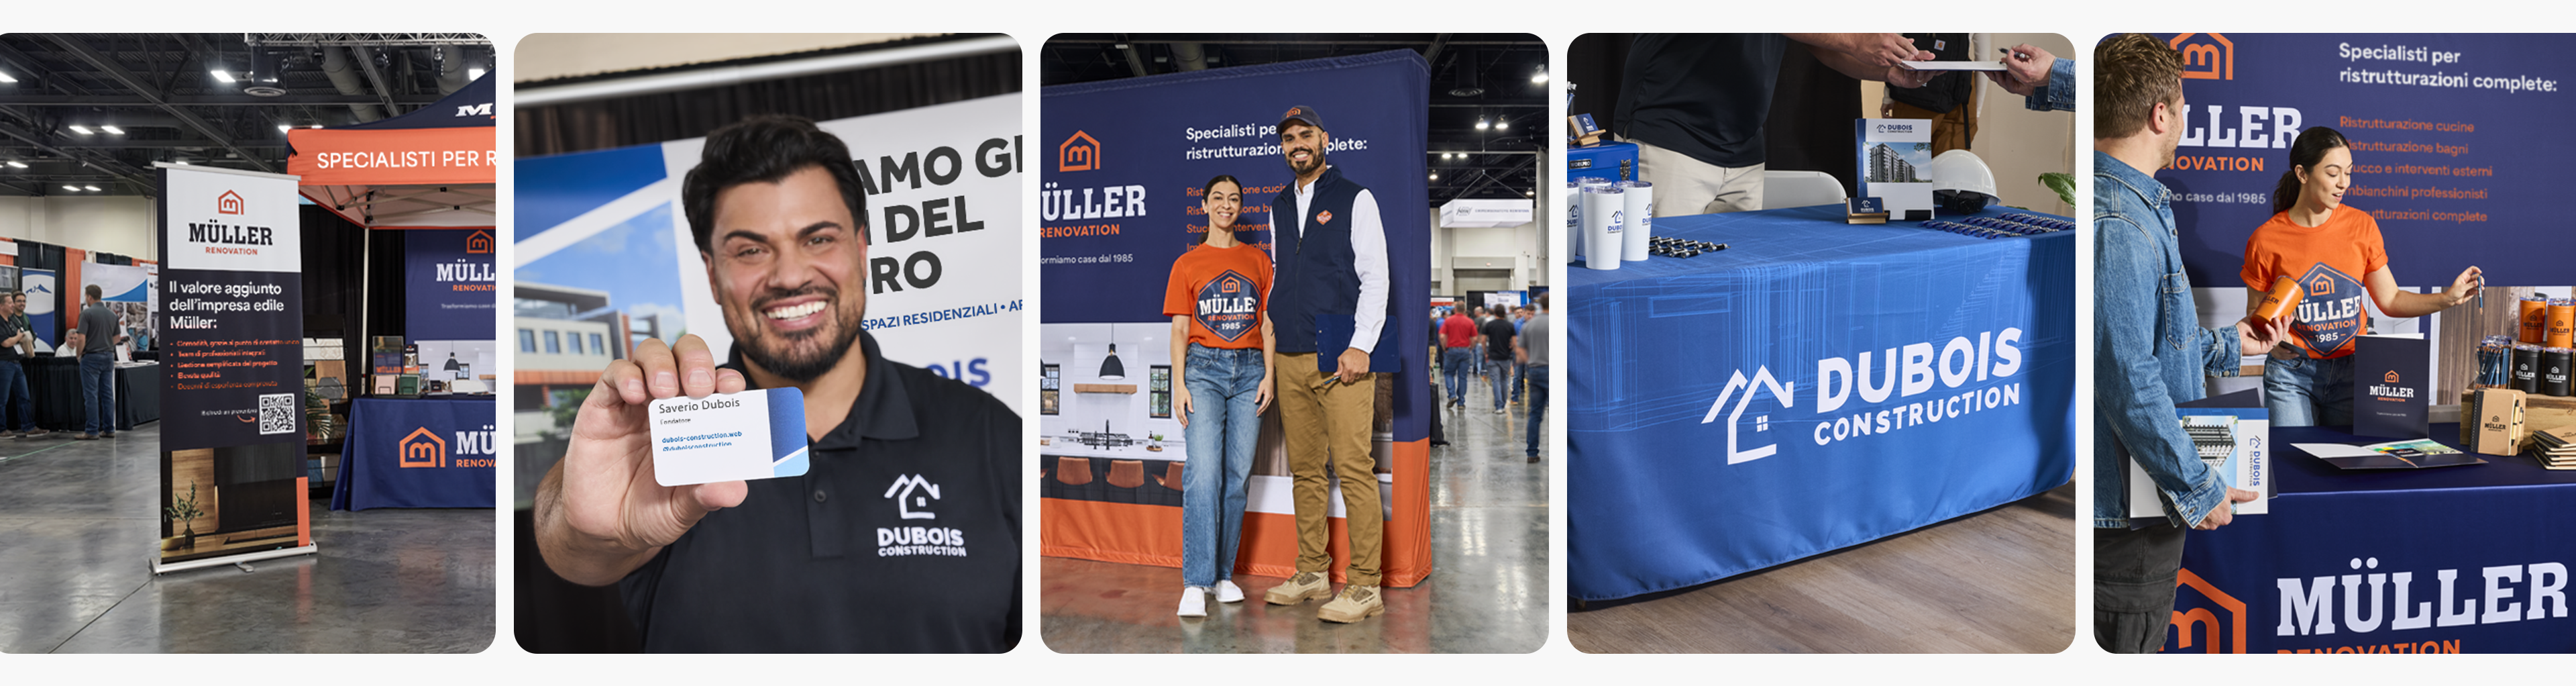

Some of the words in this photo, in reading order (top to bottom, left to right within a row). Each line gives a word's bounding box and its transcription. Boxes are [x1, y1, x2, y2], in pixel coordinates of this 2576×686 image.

[2339, 42, 2427, 62] Specialisti
[2432, 51, 2461, 66] per
[2340, 67, 2468, 87] ristrutturazioni
[2473, 75, 2557, 93] complete:
[2340, 115, 2433, 130] Ristrutturazione
[2436, 121, 2474, 132] cucine
[1186, 124, 1255, 142] Specialisti
[2347, 140, 2433, 153] istrutturazione
[2436, 142, 2468, 157] bagni
[317, 151, 435, 169] SPECIALISTI
[443, 150, 479, 166] PER
[2351, 164, 2382, 174] ucco
[2385, 165, 2392, 174] e
[2395, 163, 2450, 176] interventi
[2453, 166, 2492, 177] esterni
[2186, 194, 2214, 202] case
[2216, 192, 2235, 203] dal
[2237, 193, 2266, 204] 1985
[2412, 187, 2487, 199] professionisti
[884, 195, 984, 243] DEL
[2432, 209, 2488, 224] complete
[189, 219, 273, 246] MÜLLER
[205, 246, 258, 255] RENOVATION
[1098, 254, 1112, 262] dal
[1113, 254, 1133, 262] 1985
[864, 250, 942, 294] RO
[170, 281, 176, 293] Il
[180, 281, 222, 294] valore
[225, 282, 282, 297] aggiunto
[254, 299, 284, 311] edile
[170, 315, 217, 329] Müller:
[862, 316, 900, 331] SPAZI
[903, 303, 998, 326] RESIDENZIALI
[2297, 318, 2356, 332] RENOVATION
[2315, 332, 2339, 343] 1985
[1817, 327, 2022, 413] DUBOIS
[2369, 383, 2414, 398] MÜLLER
[659, 402, 698, 413] Saverio
[702, 398, 740, 409] Dubois
[1814, 383, 2020, 446] CONSTRUCTION
[2484, 422, 2506, 430] MÜLLER
[662, 431, 742, 443] dubois-construction.web
[2253, 451, 2261, 487] DUBOIS
[877, 526, 964, 547] DUBOIS
[878, 545, 967, 556] CONSTRUCTION
[2277, 557, 2568, 636] MÜLLER
